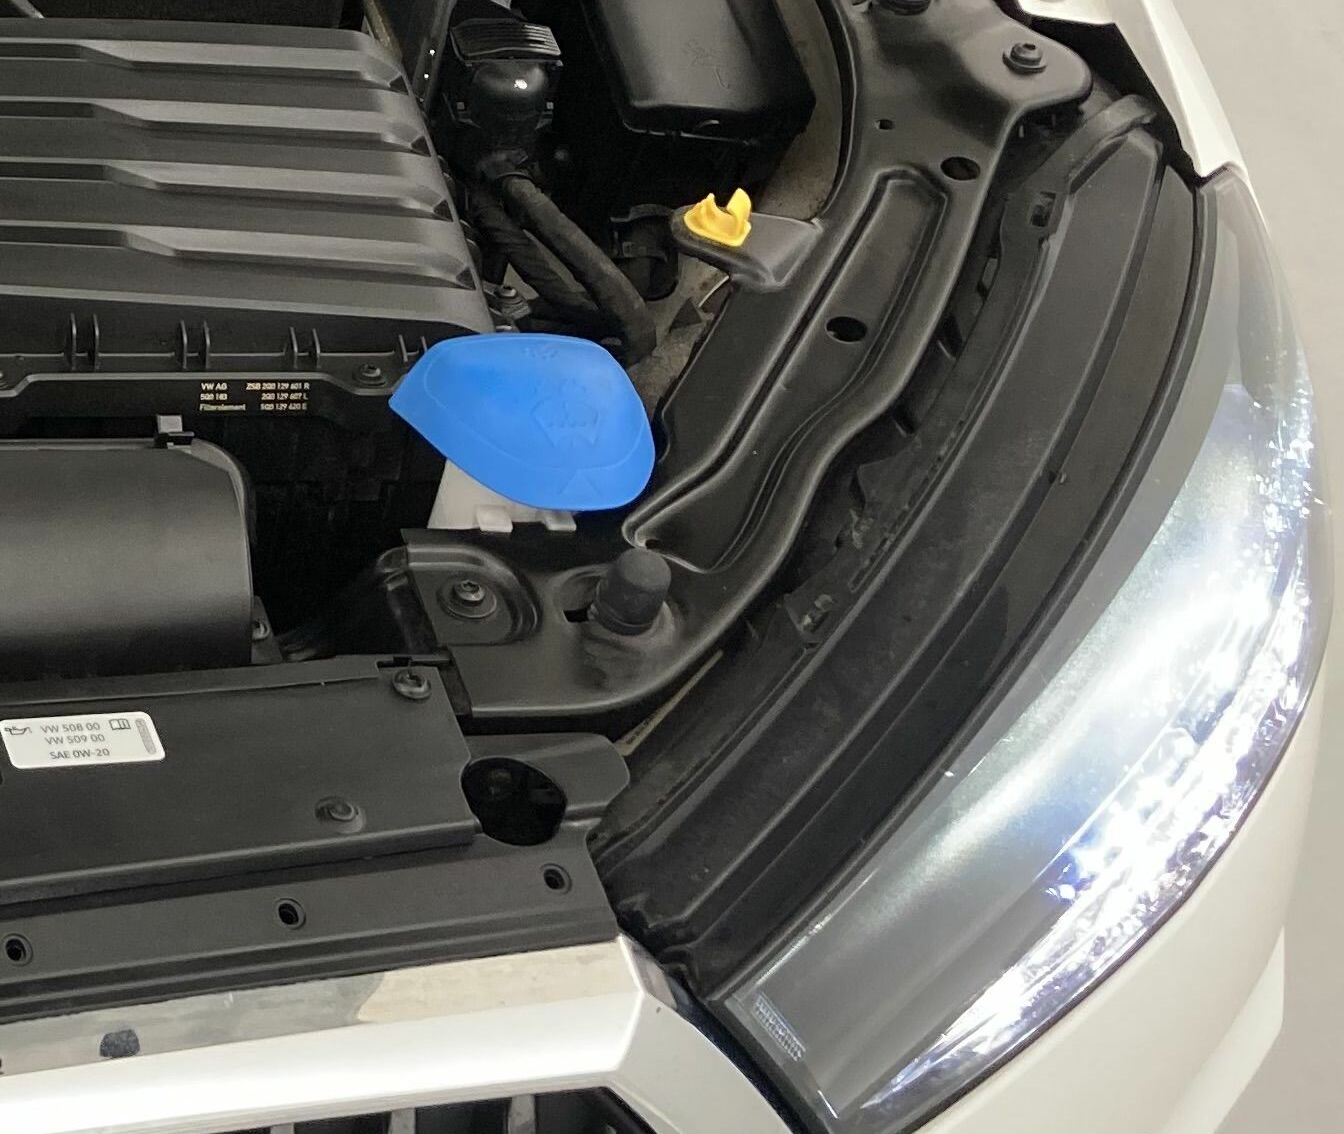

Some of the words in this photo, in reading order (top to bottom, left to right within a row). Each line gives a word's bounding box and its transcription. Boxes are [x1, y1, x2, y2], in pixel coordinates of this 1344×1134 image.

[201, 382, 215, 390] VW
[215, 382, 228, 390] AG
[40, 725, 59, 733] VW
[62, 723, 83, 732] 508
[86, 722, 100, 730] 00
[45, 736, 64, 744] VW
[67, 734, 87, 744] 509
[90, 734, 105, 742] 00
[50, 749, 71, 760] SAE
[72, 747, 110, 758] 0W-20
